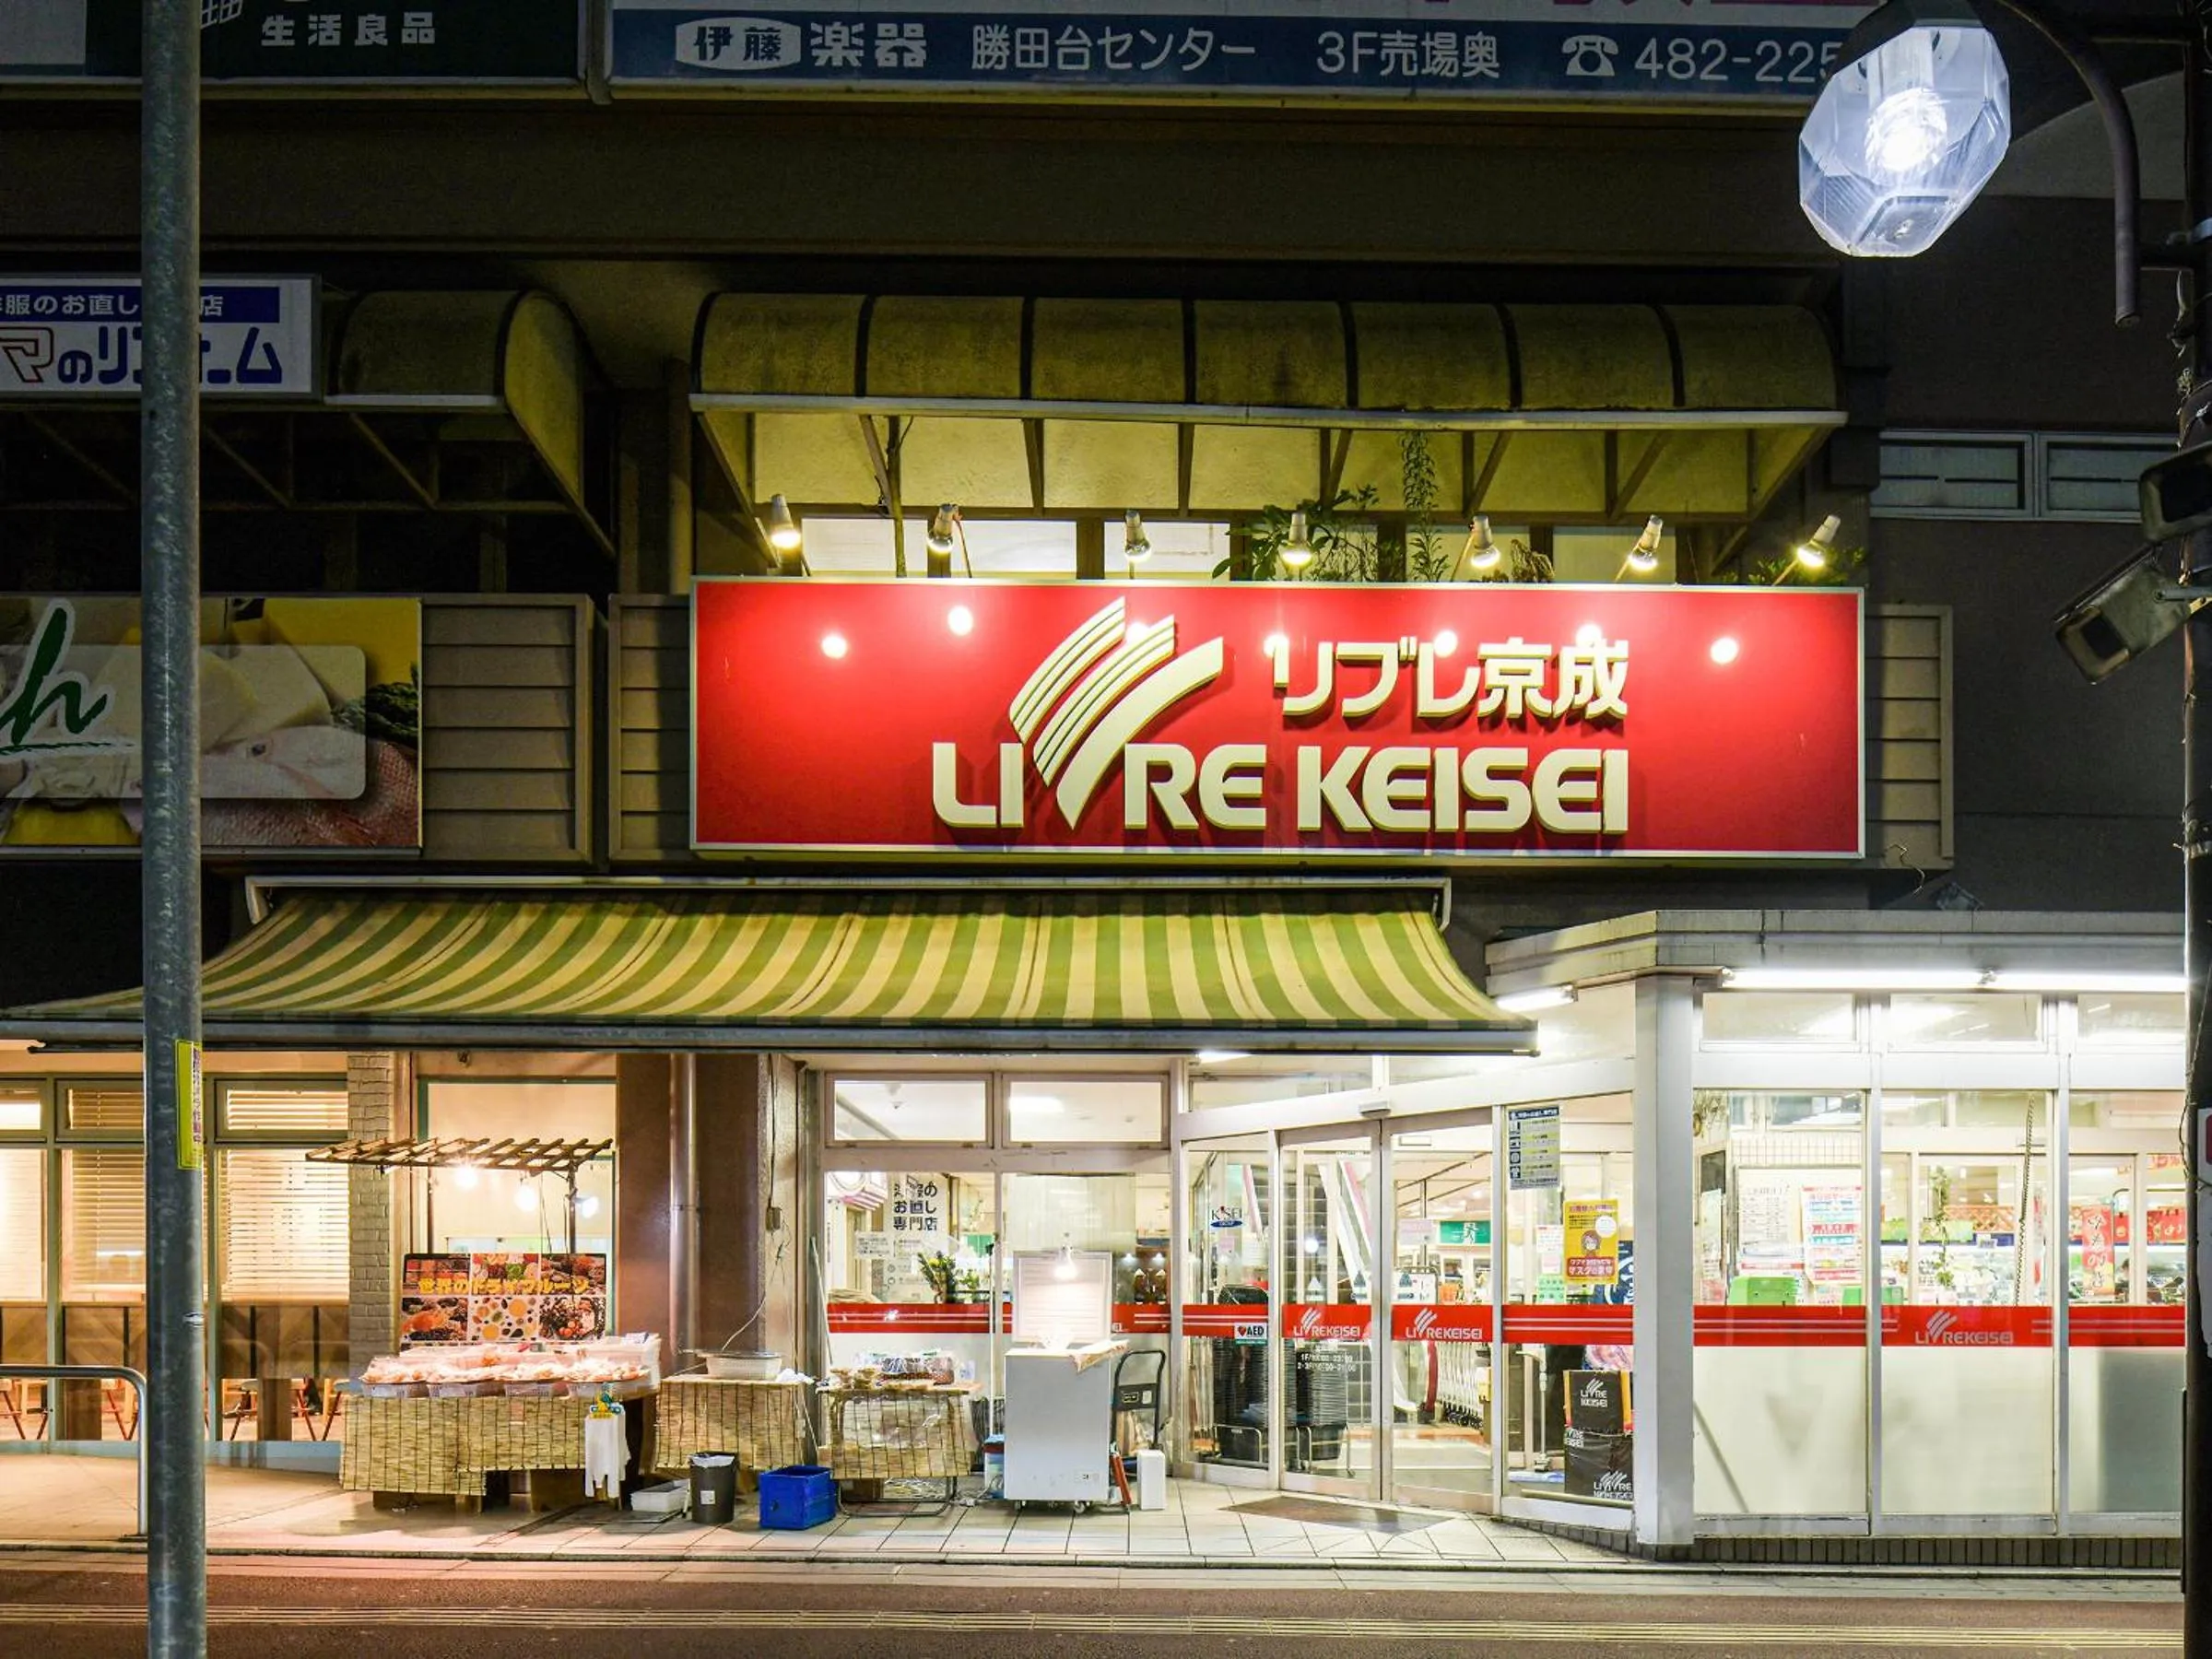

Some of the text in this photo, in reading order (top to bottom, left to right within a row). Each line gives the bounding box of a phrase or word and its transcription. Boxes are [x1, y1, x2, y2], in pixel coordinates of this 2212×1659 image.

[261, 11, 436, 46] 生活良品
[971, 24, 1257, 72] 勝田台センター
[1317, 29, 1500, 79] 3F売場奥
[1273, 636, 1629, 719] リブレ京成
[1298, 746, 1630, 834] KEISEI
[1246, 1325, 1265, 1335] AED
